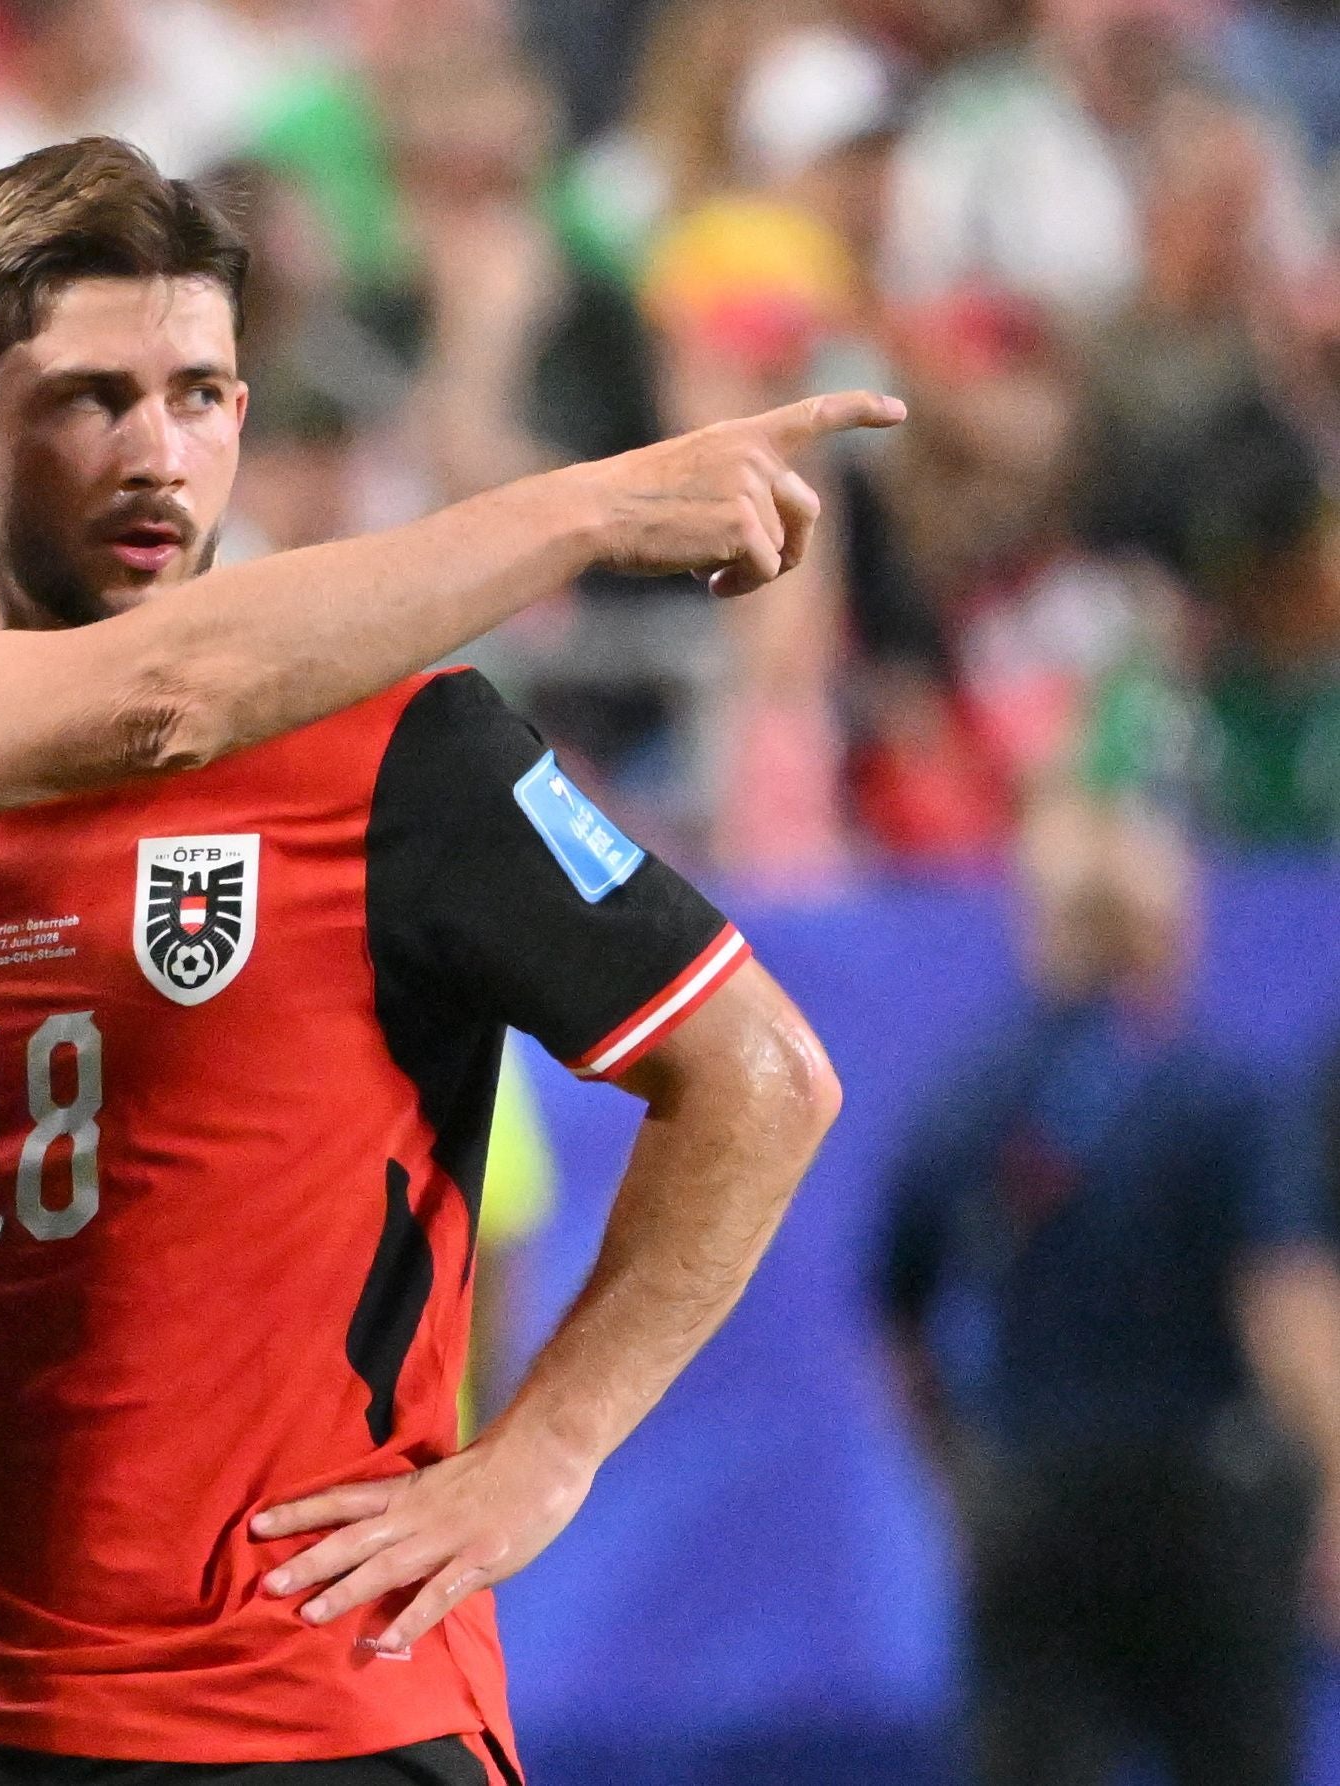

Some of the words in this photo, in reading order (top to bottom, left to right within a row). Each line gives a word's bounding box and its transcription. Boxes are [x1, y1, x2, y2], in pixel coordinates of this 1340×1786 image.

[173, 846, 222, 862] ÖFB
[26, 915, 79, 930] Österreich
[10, 936, 33, 949] Juni
[34, 932, 59, 944] 2026
